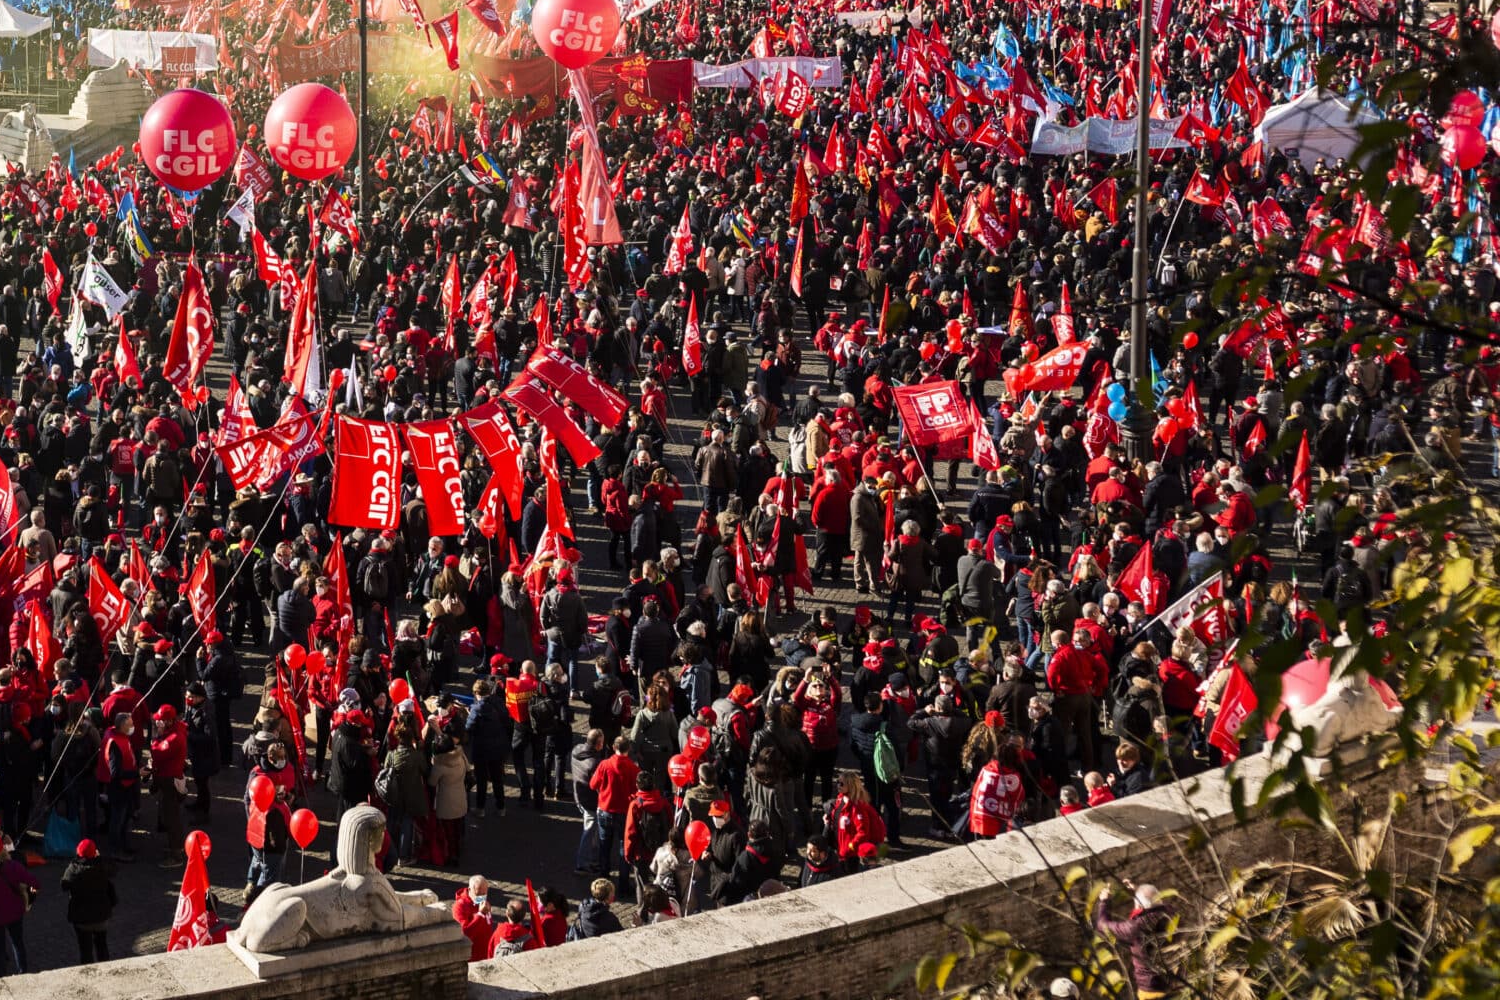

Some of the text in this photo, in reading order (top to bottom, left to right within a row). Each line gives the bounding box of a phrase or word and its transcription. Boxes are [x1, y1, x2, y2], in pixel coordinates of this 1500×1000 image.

[561, 9, 604, 34] FLC
[550, 28, 604, 52] CGIL
[165, 62, 178, 72] FLC
[163, 129, 215, 153] FLC
[282, 122, 334, 149] FLC
[156, 154, 222, 176] CGIL
[275, 146, 341, 169] CGIL
[915, 392, 950, 415] FP
[924, 412, 958, 427] CGIL
[980, 771, 1020, 798] FP
